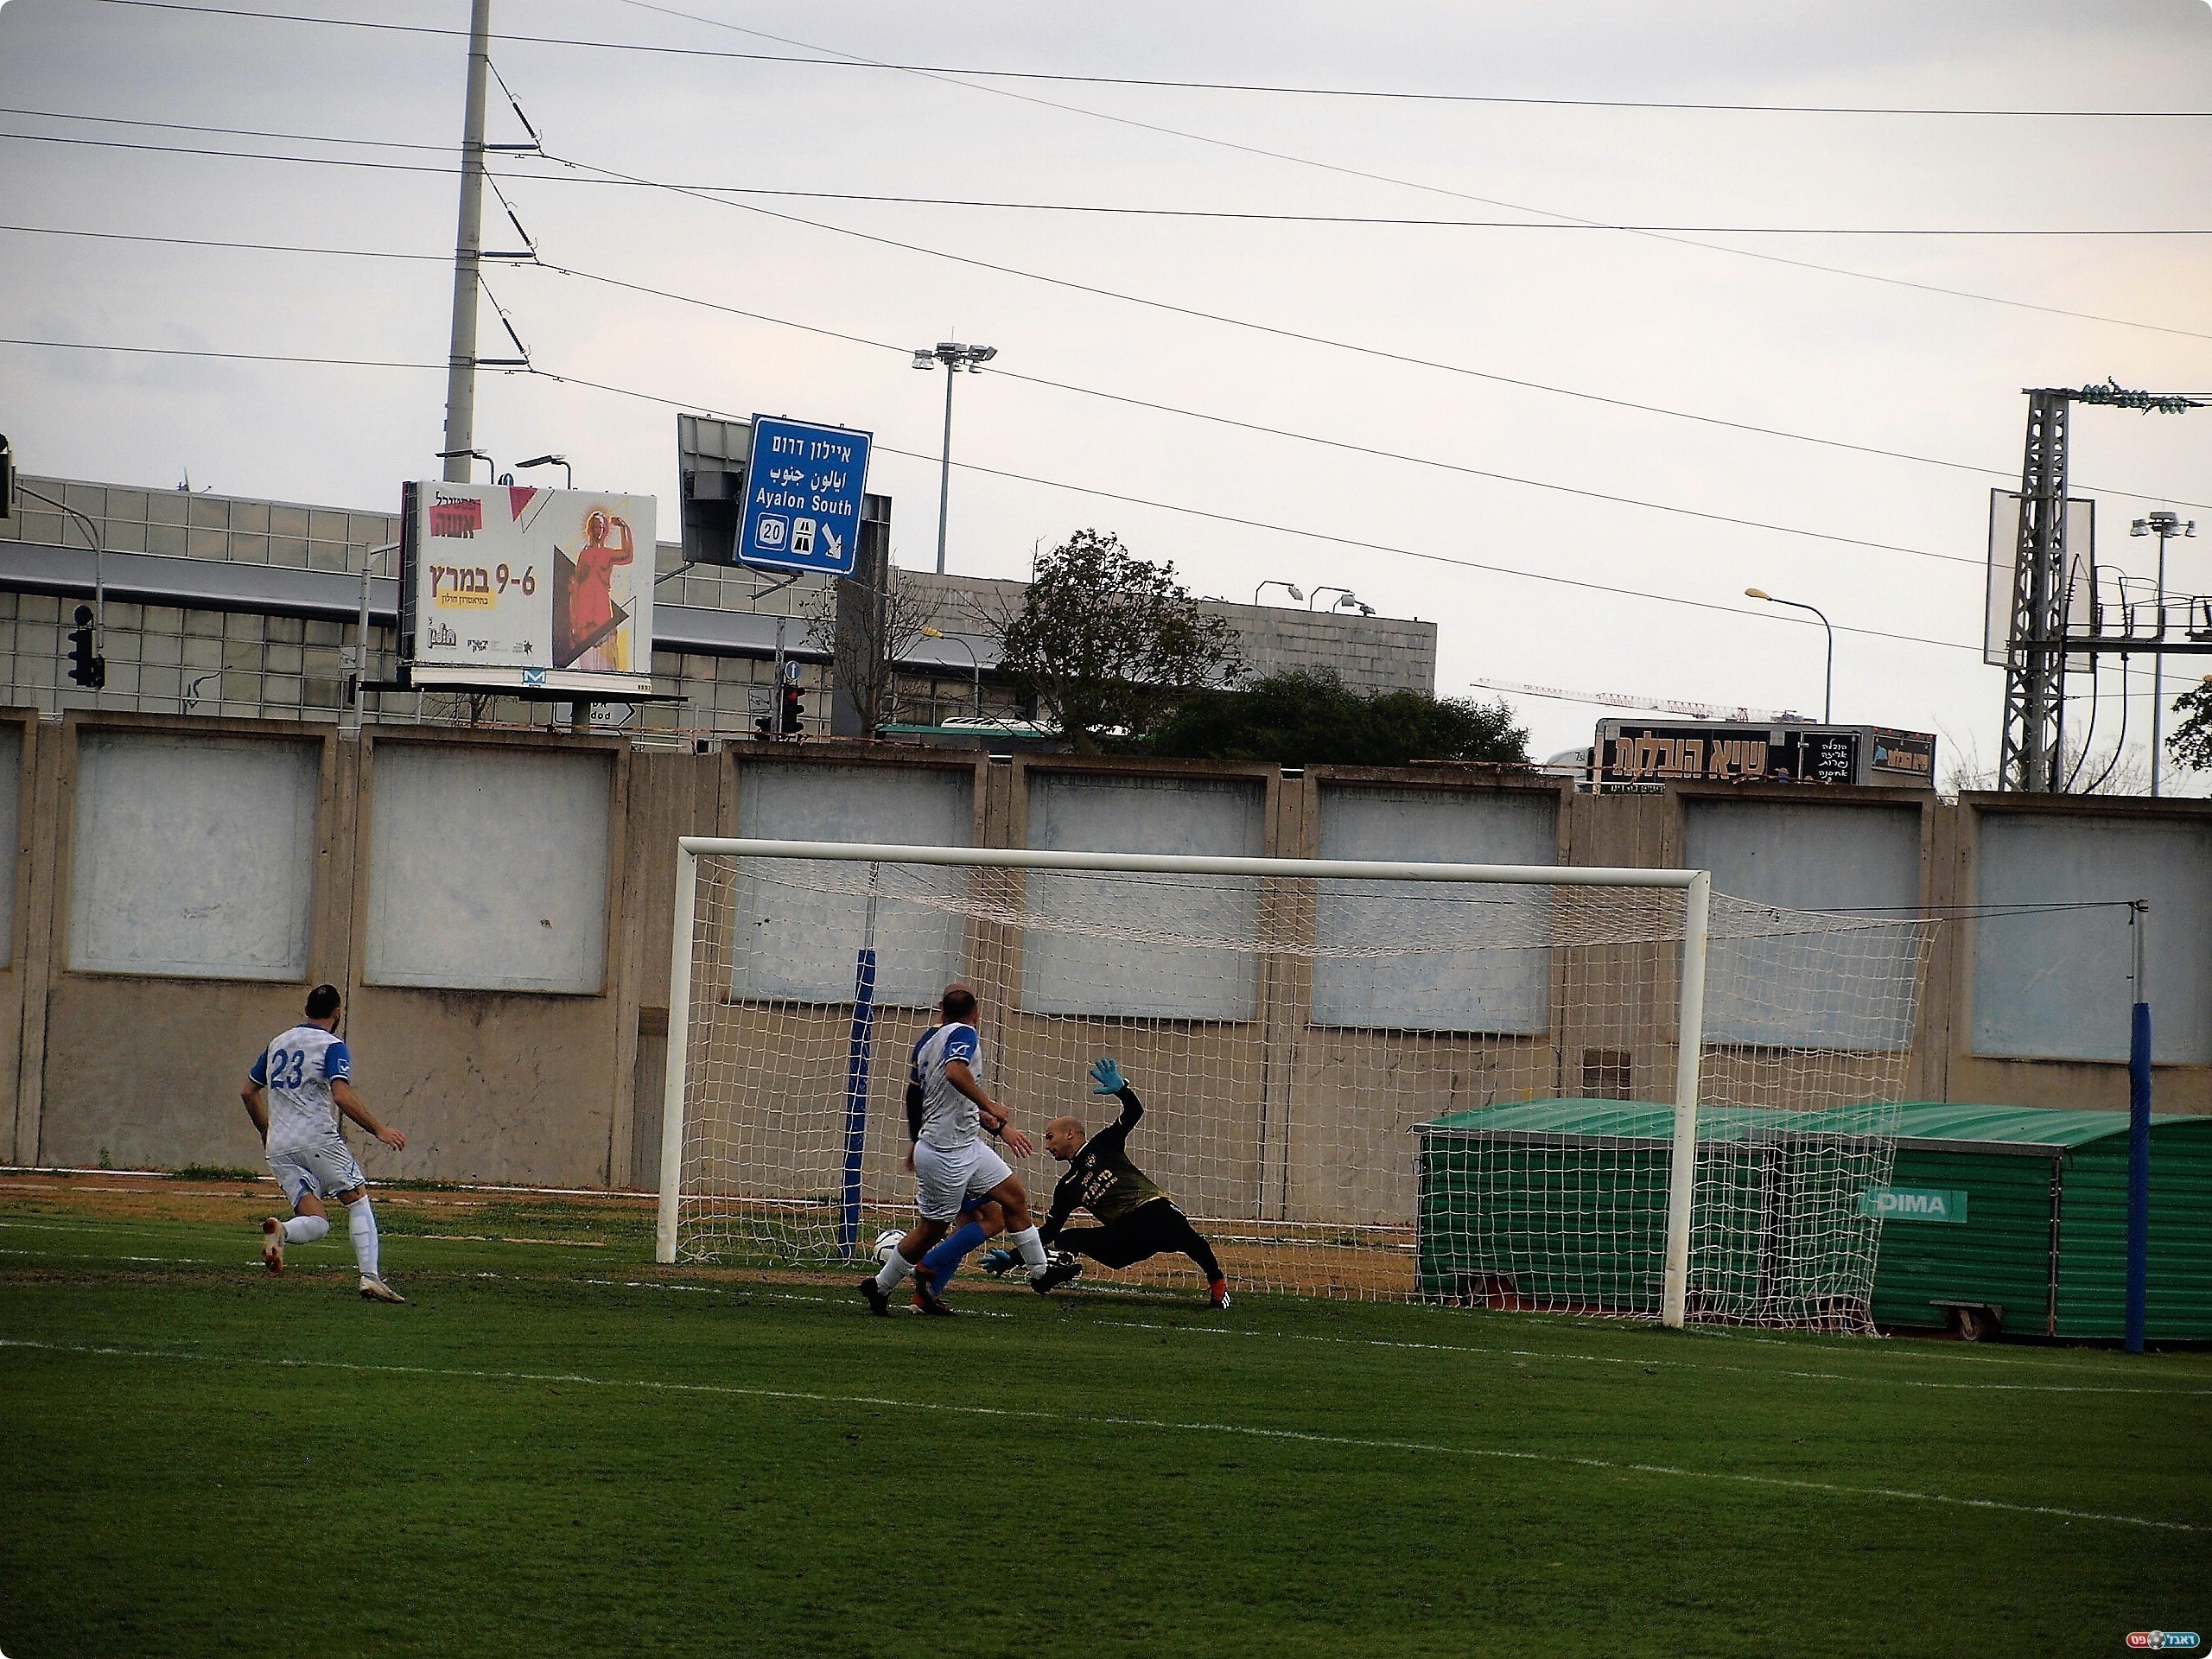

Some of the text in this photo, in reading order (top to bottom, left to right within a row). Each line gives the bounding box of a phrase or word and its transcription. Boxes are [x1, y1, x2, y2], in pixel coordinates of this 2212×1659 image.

[772, 435, 852, 463] איילון דרום
[770, 466, 805, 486] جنوب
[755, 487, 853, 516] Ayalon South
[763, 523, 781, 540] 20
[429, 565, 489, 598] במרץ
[1612, 730, 1766, 779] שיא הובלות
[270, 1048, 305, 1090] 23
[1875, 1192, 1947, 1214] DIMA
